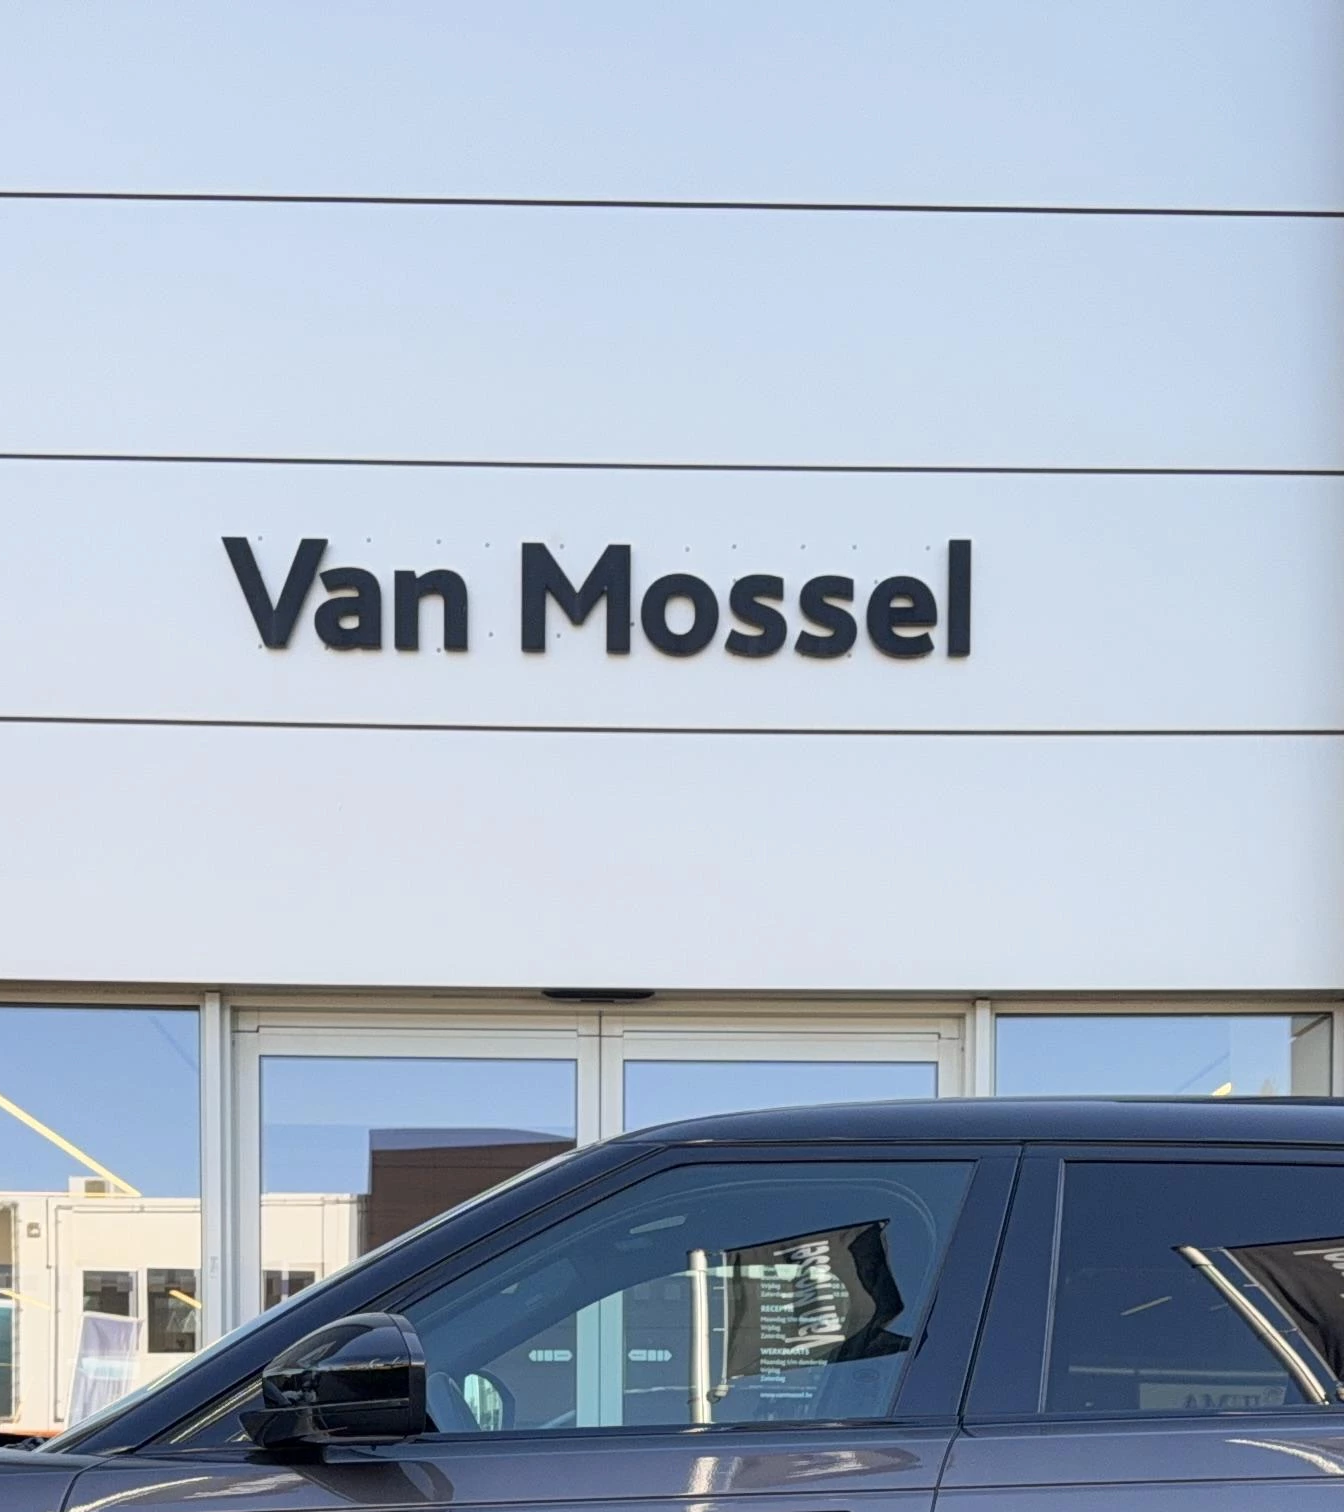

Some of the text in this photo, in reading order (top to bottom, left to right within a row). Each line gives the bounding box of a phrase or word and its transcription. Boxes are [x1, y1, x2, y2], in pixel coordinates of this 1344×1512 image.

[222, 536, 972, 660] Van Mossel
[785, 1305, 846, 1351] Van
